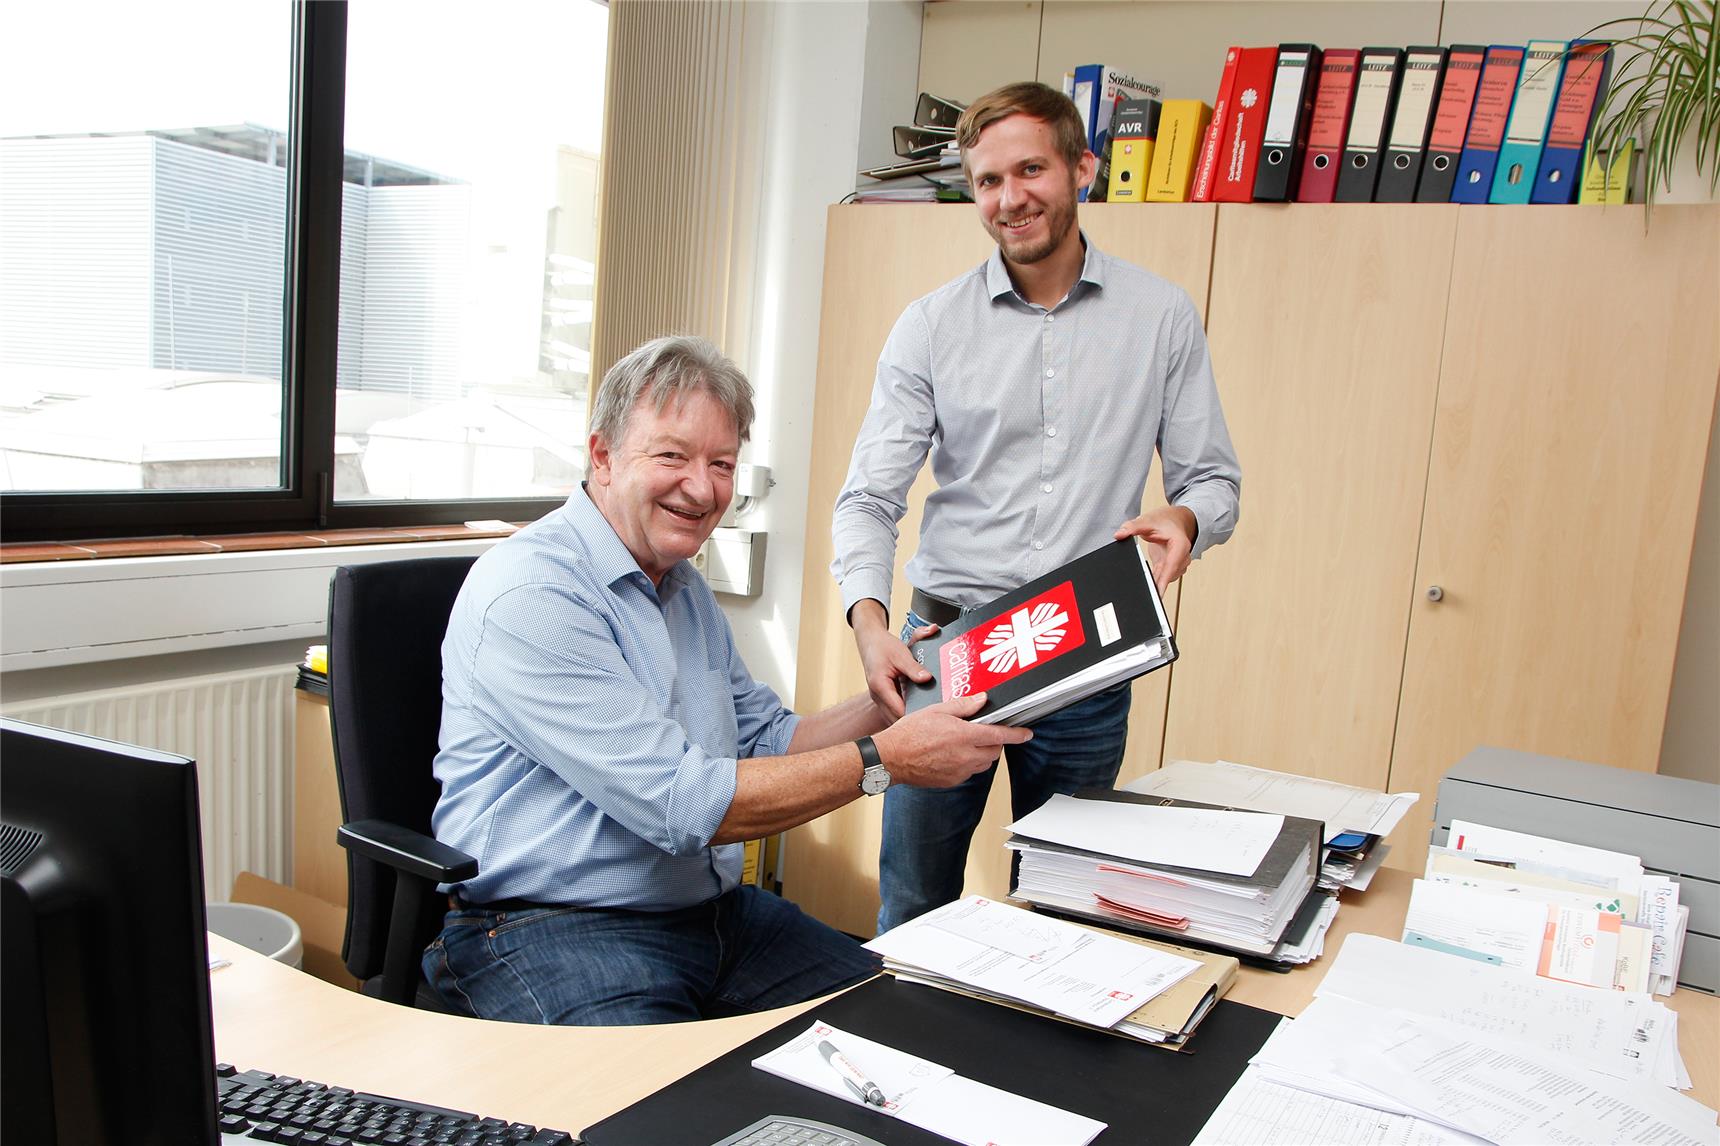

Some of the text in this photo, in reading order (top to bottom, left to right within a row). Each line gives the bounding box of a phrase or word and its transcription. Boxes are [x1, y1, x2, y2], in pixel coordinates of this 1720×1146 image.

[1108, 71, 1161, 97] Sozialcourage
[1213, 100, 1225, 126] Caritas
[1118, 122, 1142, 134] AVR
[949, 642, 974, 698] caritas
